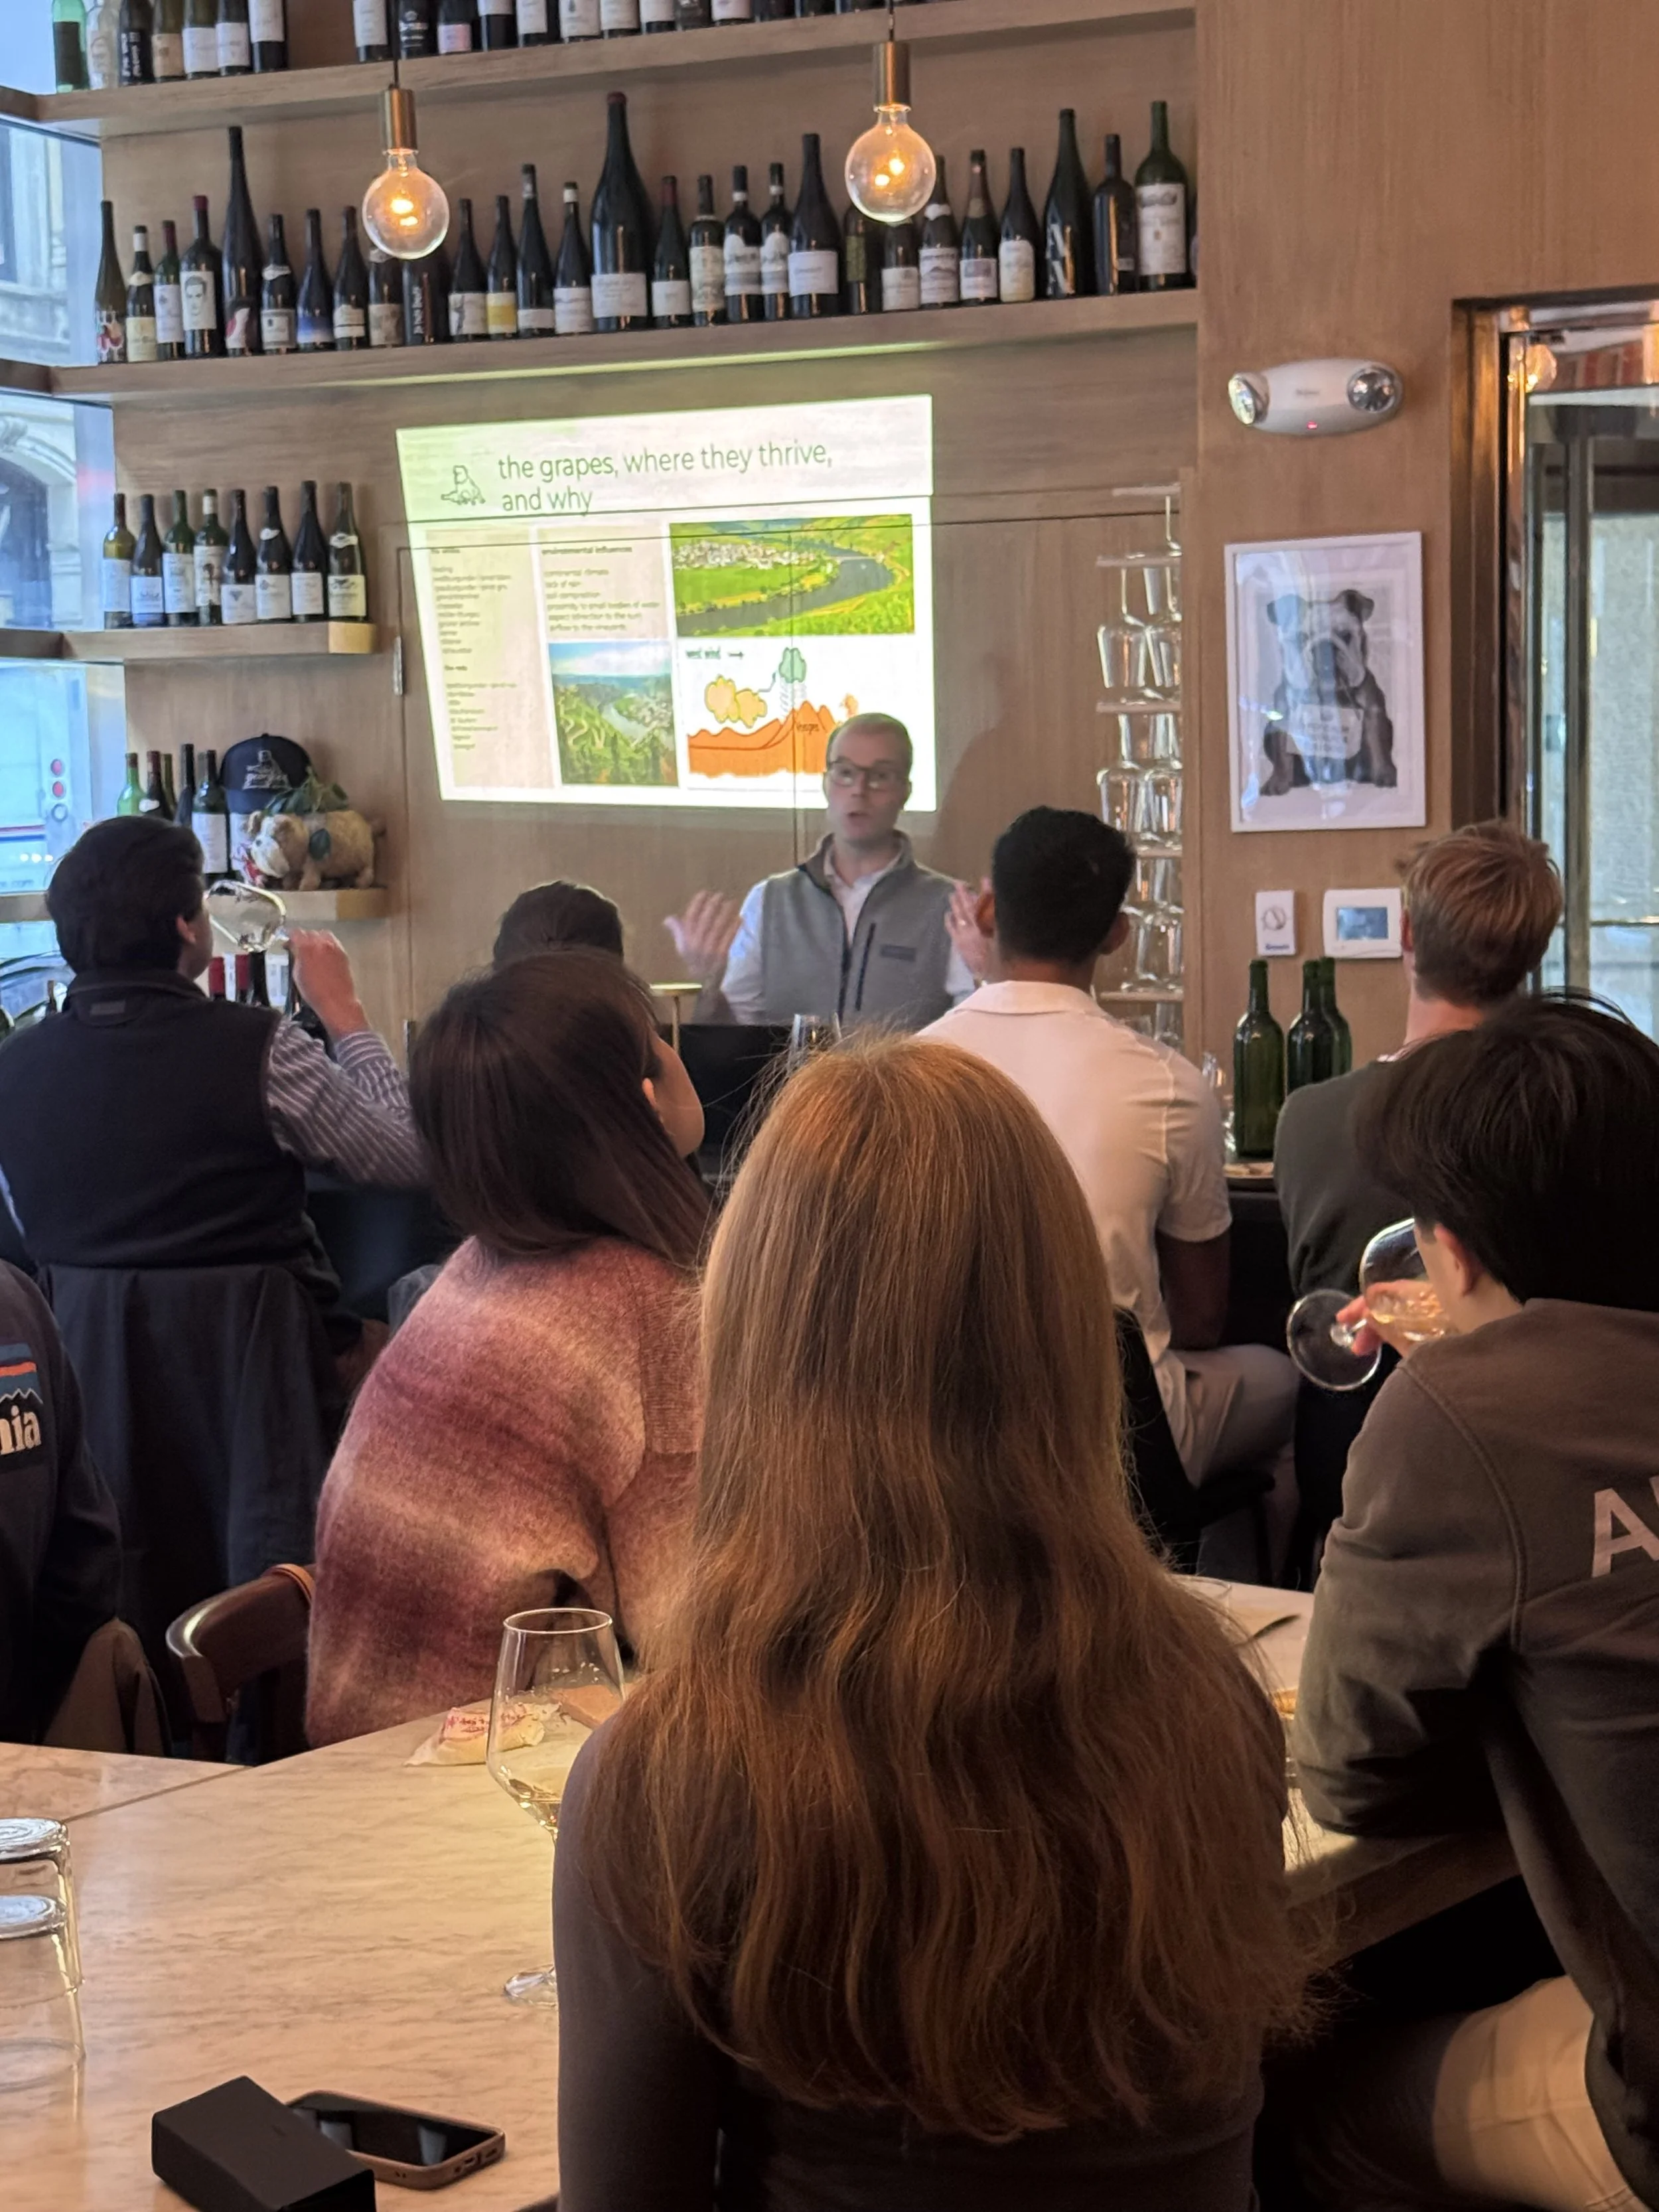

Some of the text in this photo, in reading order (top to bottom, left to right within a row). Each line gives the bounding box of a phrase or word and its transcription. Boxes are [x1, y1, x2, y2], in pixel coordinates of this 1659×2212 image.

[498, 439, 833, 483] the grapes, where they thrive,
[502, 485, 593, 516] and why
